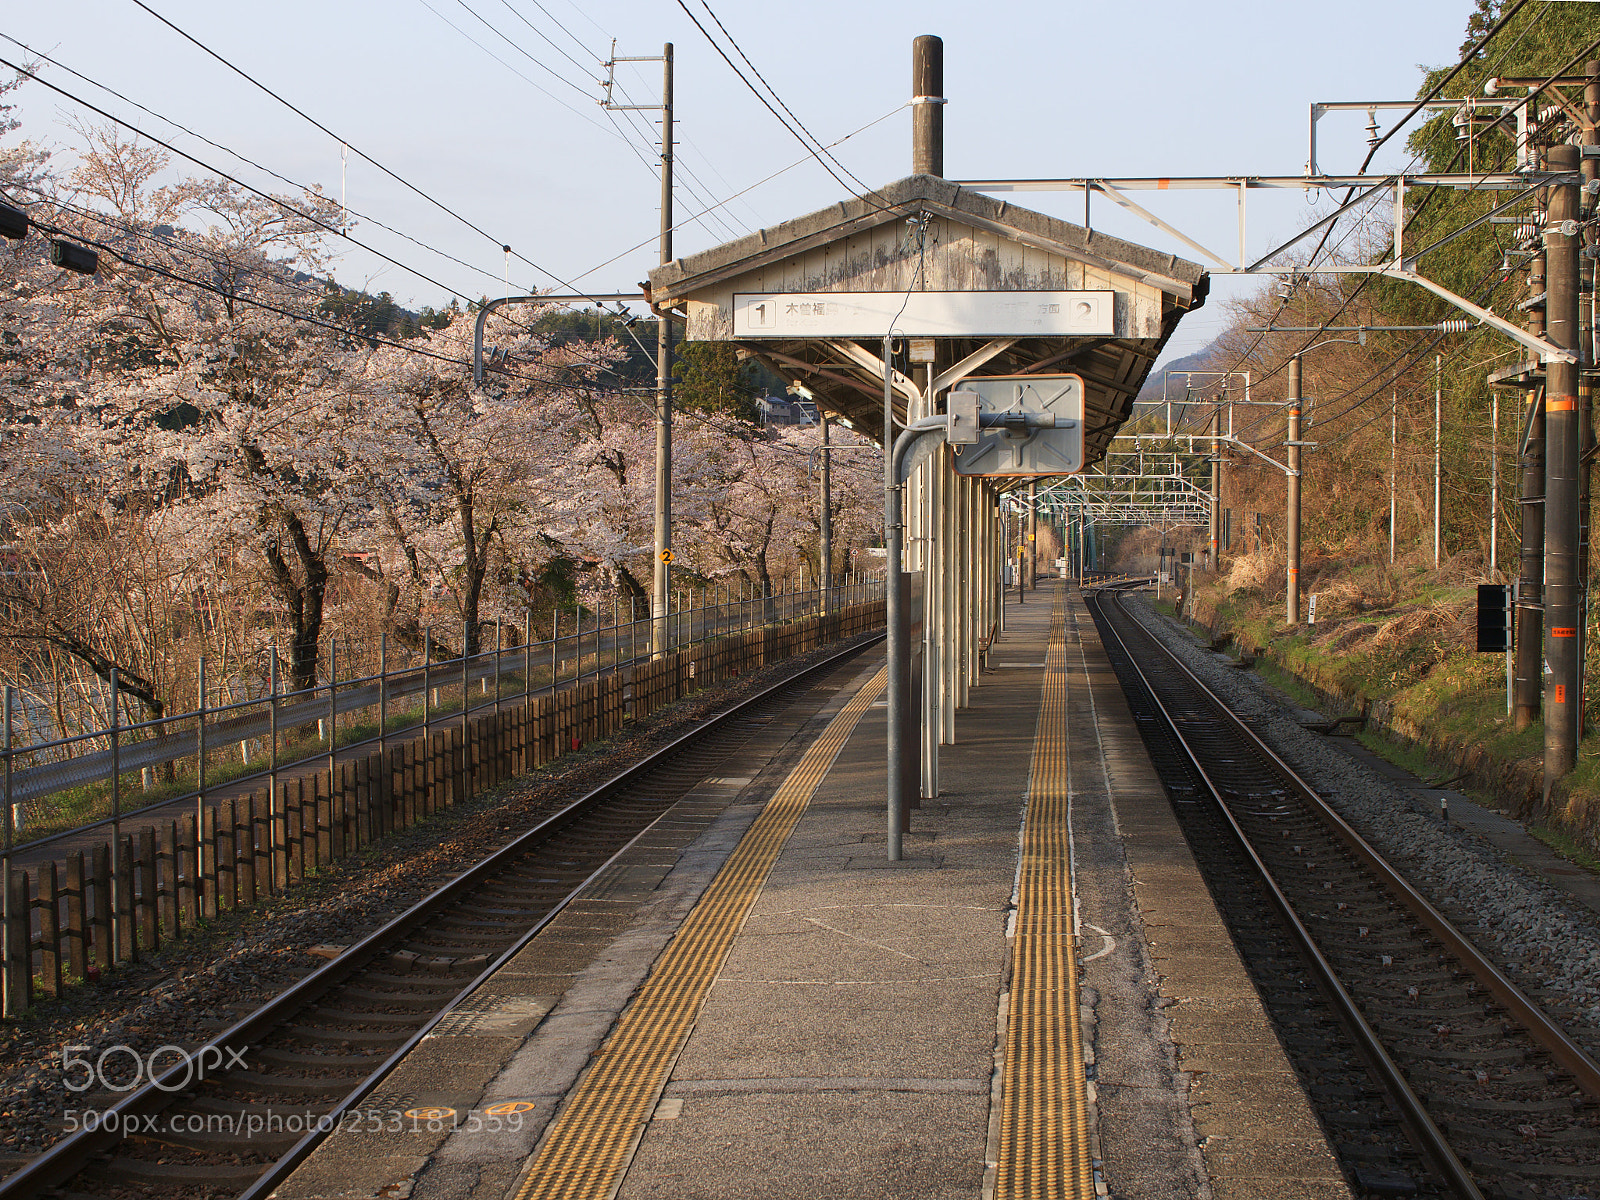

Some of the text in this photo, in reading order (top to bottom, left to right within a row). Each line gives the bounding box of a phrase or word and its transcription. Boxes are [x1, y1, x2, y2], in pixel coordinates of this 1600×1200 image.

[755, 303, 766, 326] 1
[1076, 302, 1092, 321] 2
[662, 550, 671, 562] 2
